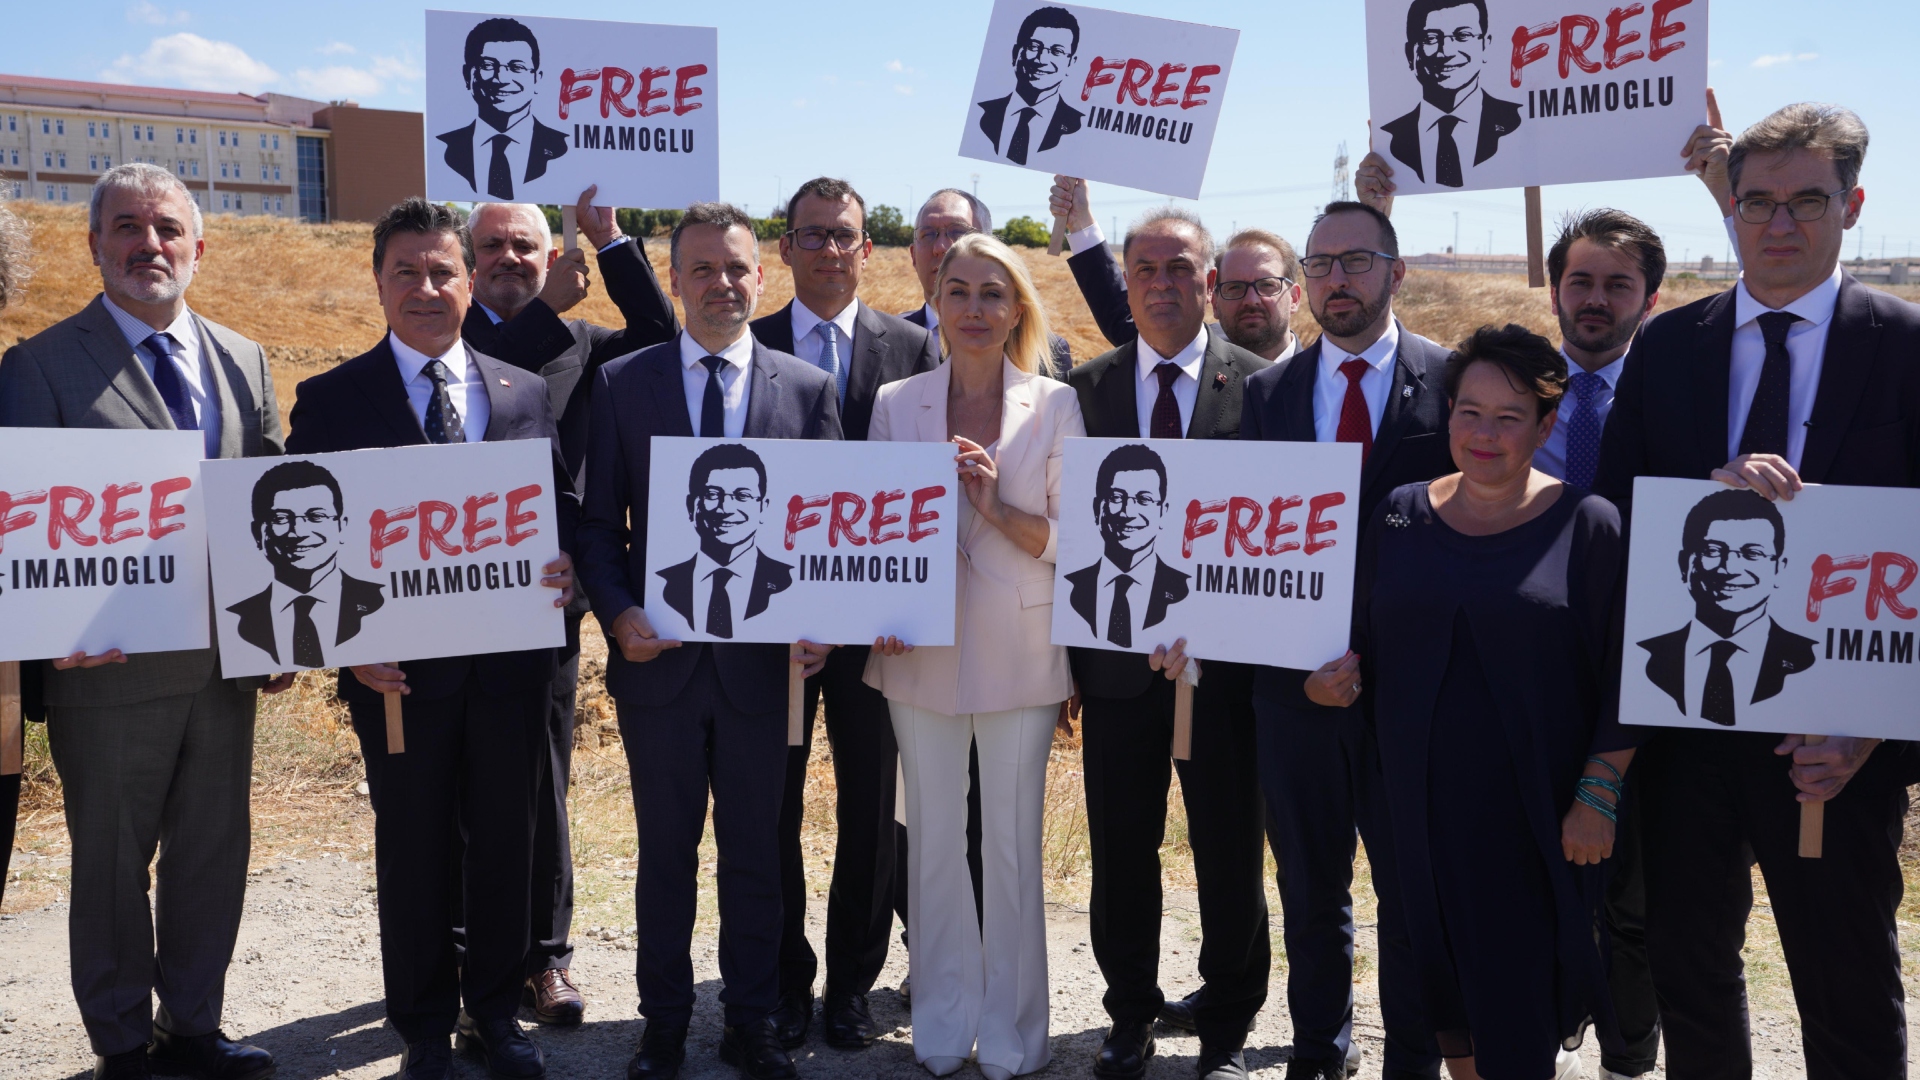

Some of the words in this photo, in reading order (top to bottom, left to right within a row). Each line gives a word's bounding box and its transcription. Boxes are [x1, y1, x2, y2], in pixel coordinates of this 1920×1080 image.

[1510, 0, 1693, 87] FREE
[558, 63, 708, 119] FREE
[1081, 56, 1221, 109] FREE
[1528, 75, 1674, 118] IMAMOGLU
[574, 122, 695, 153] IMAMOGLU
[1087, 106, 1194, 144] IMAMOGLU
[0, 476, 192, 554] FREE
[369, 484, 542, 568] FREE
[785, 485, 946, 551] FREE
[1182, 491, 1345, 559] FREE
[11, 555, 175, 589] IMAMOGLU
[390, 560, 532, 598] IMAMOGLU
[799, 555, 929, 583] IMAMOGLU
[1195, 563, 1325, 600] IMAMOGLU
[1825, 628, 1920, 664] IMAM
